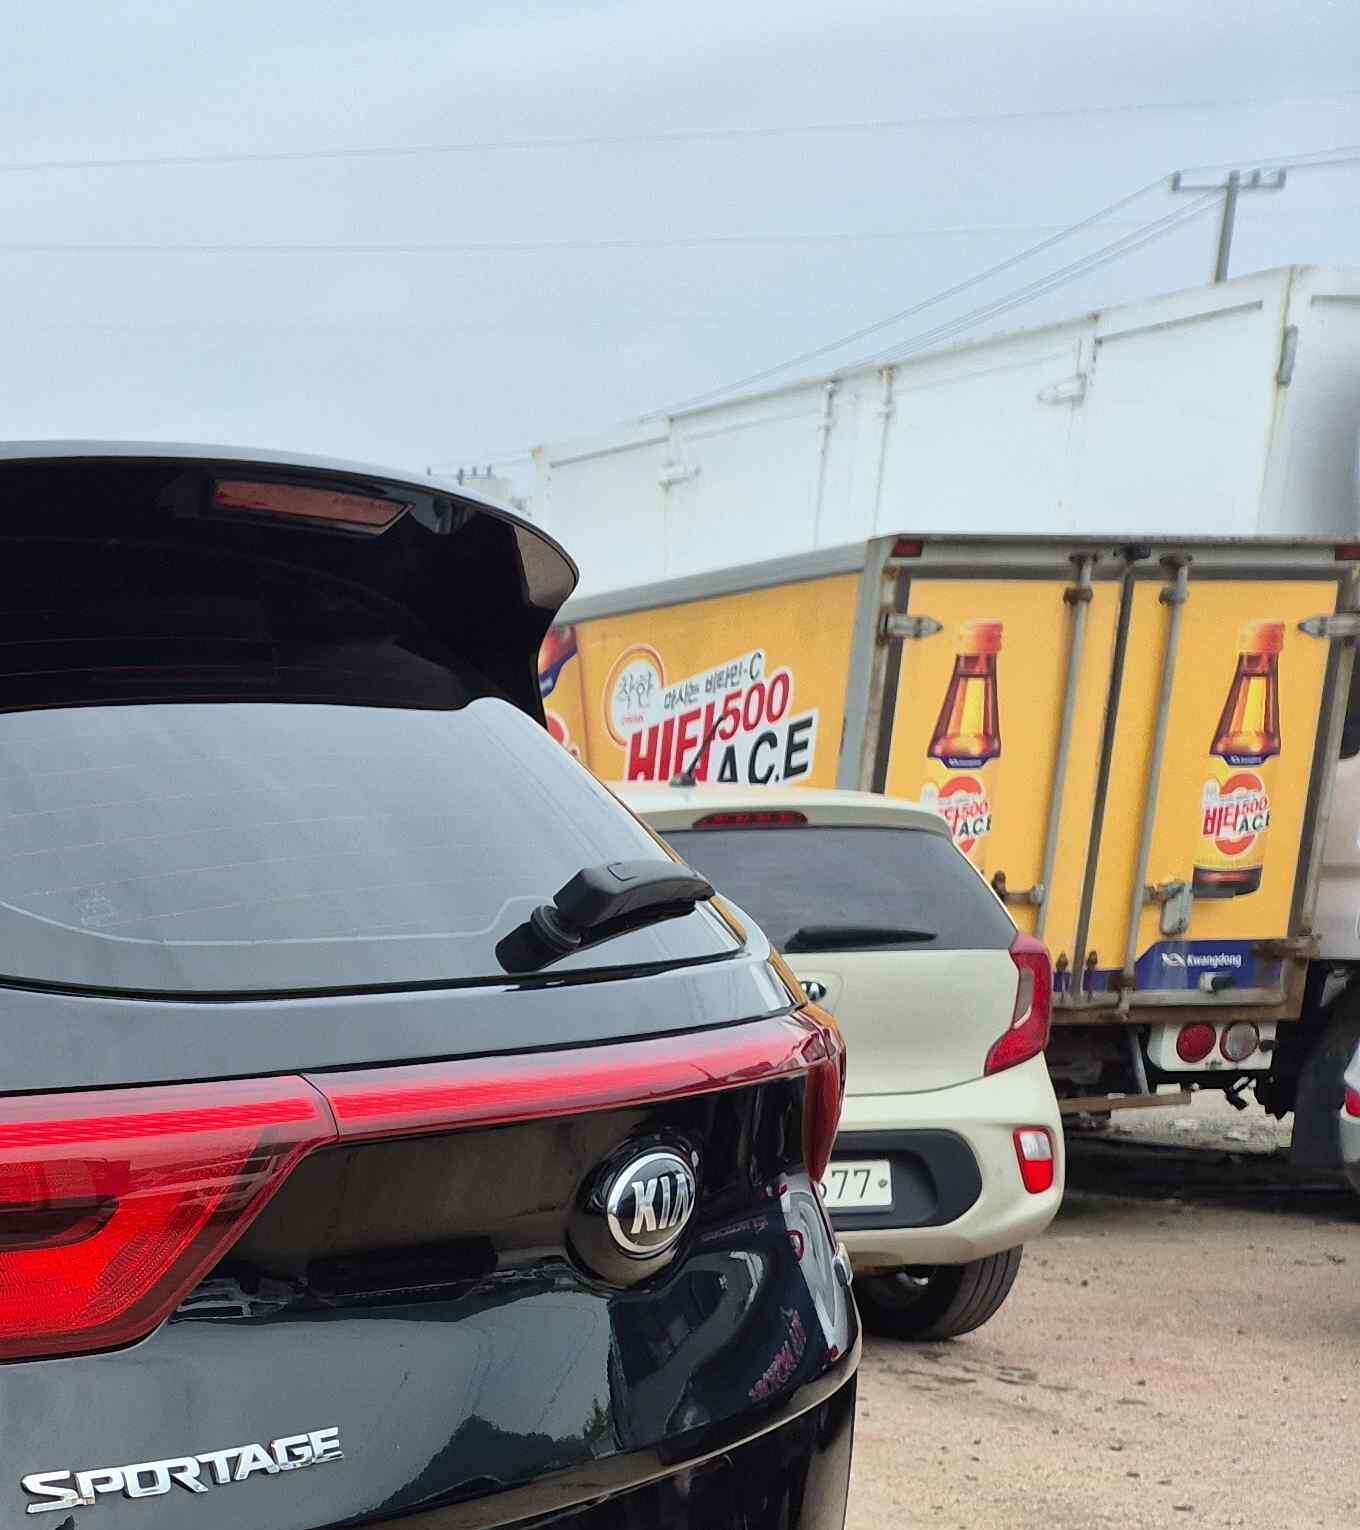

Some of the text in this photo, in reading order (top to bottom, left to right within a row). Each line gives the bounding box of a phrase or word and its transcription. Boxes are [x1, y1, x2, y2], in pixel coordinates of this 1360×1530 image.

[1187, 952, 1242, 968] Kwangdong
[631, 1173, 690, 1234] KIA
[21, 1425, 345, 1514] SPORTAGE
